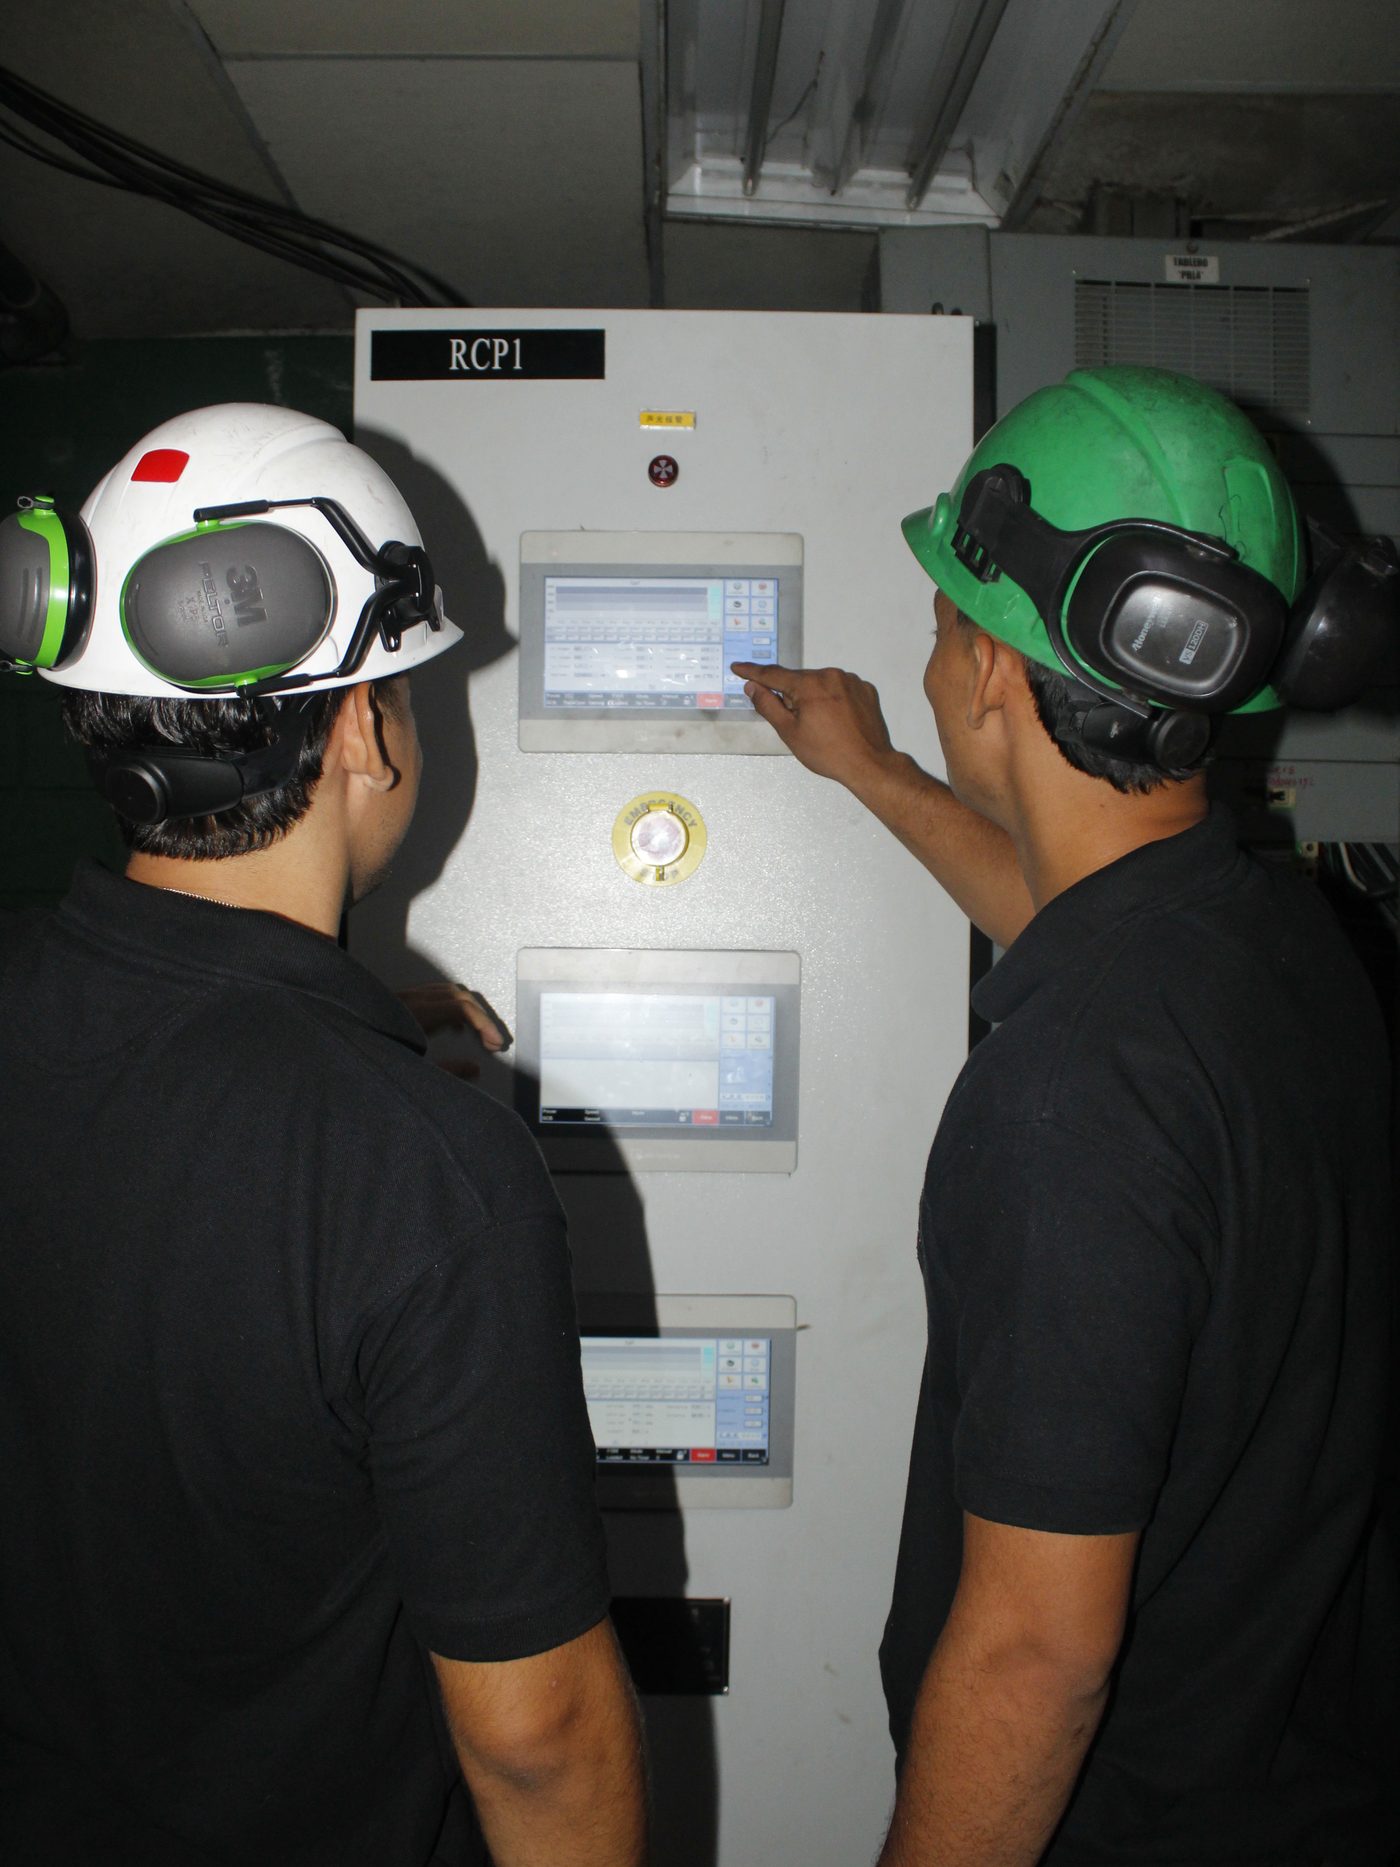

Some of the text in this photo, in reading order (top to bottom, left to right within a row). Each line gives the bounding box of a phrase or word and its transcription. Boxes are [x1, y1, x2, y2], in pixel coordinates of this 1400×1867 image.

[449, 338, 524, 371] RCP1
[198, 560, 230, 647] PELTOR
[226, 564, 268, 627] 3M
[1131, 597, 1163, 651] Honeyw
[1181, 650, 1194, 662] VS
